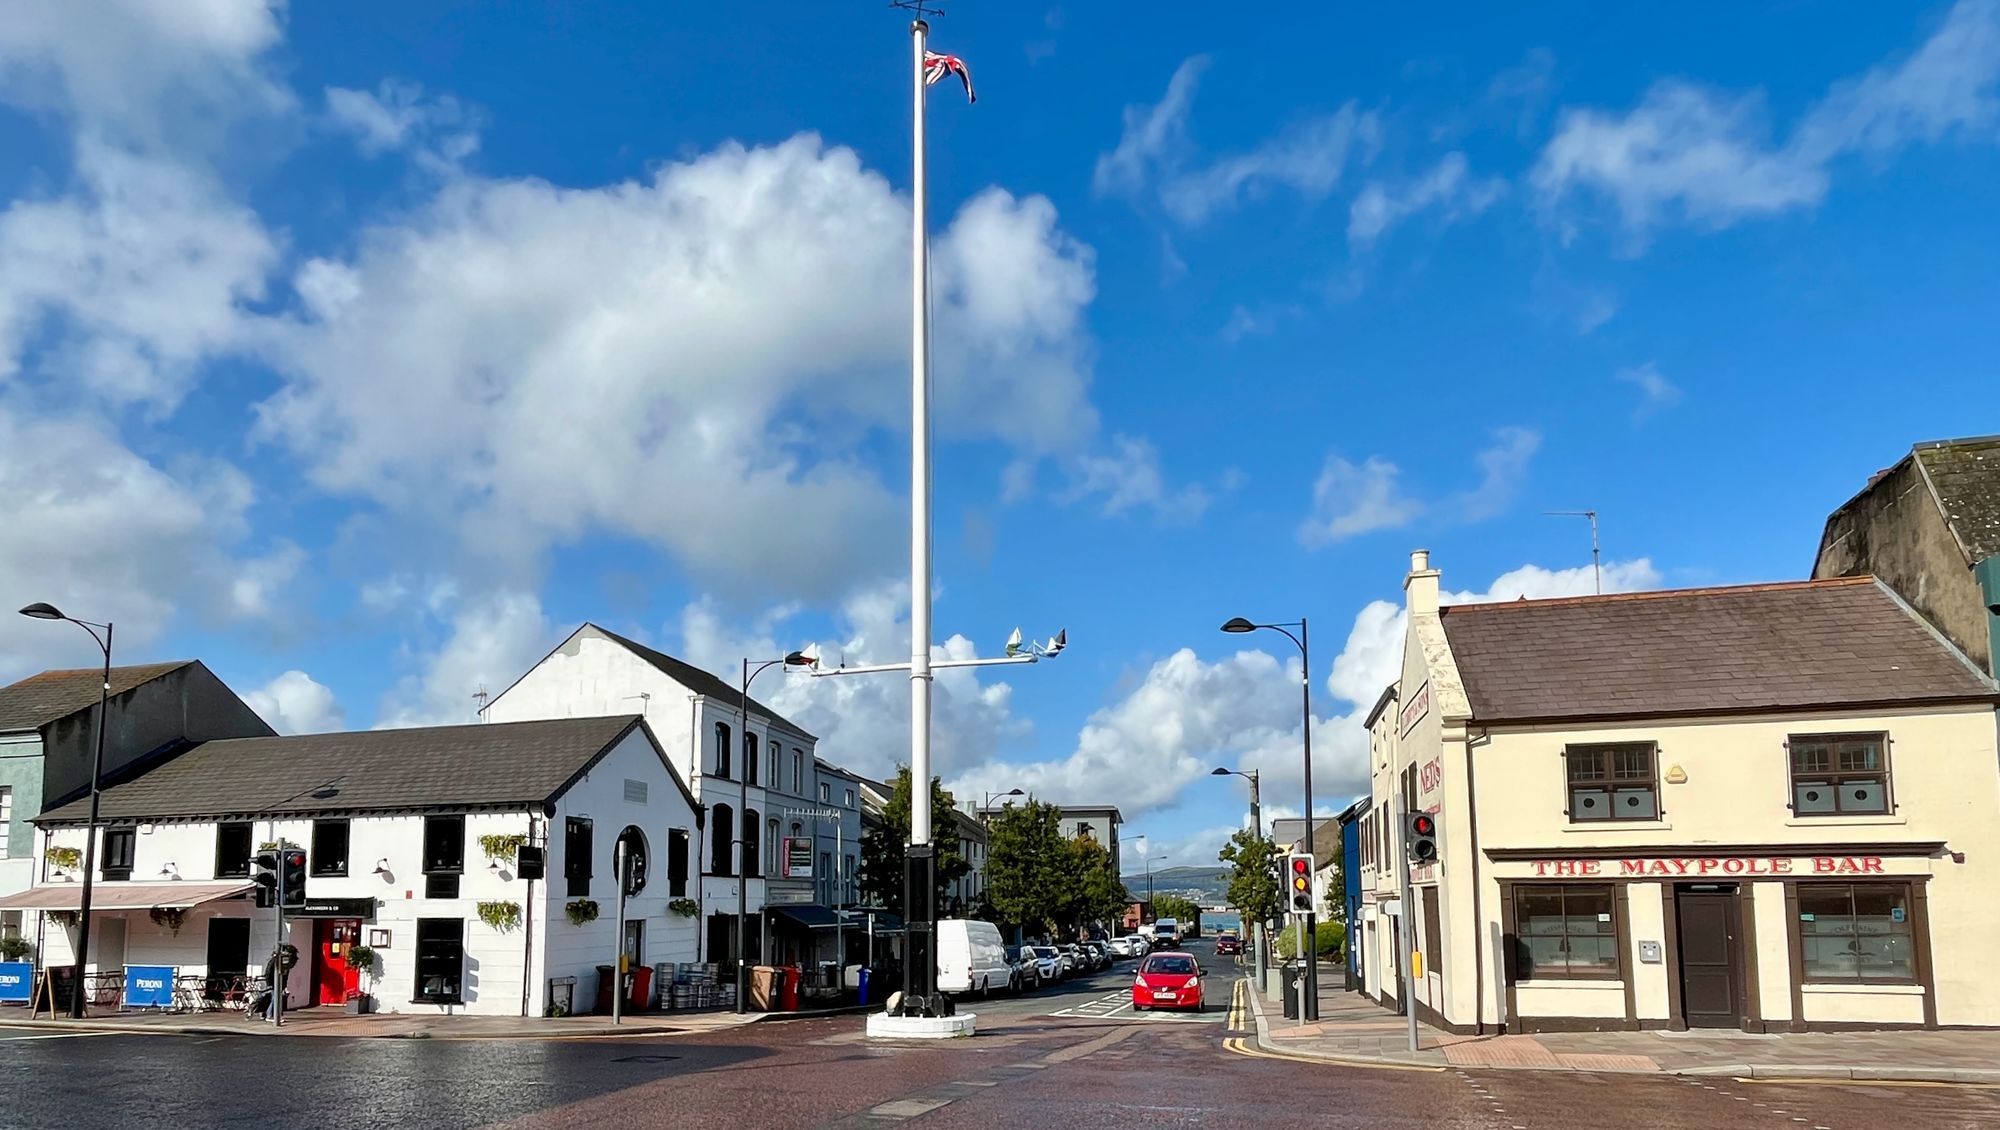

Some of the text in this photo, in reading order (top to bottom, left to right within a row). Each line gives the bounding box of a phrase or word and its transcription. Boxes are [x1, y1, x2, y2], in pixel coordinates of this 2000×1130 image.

[1531, 856, 1885, 876] THE MAYPOLE BAR
[0, 975, 20, 984] ERONI
[136, 978, 163, 989] PERONI
